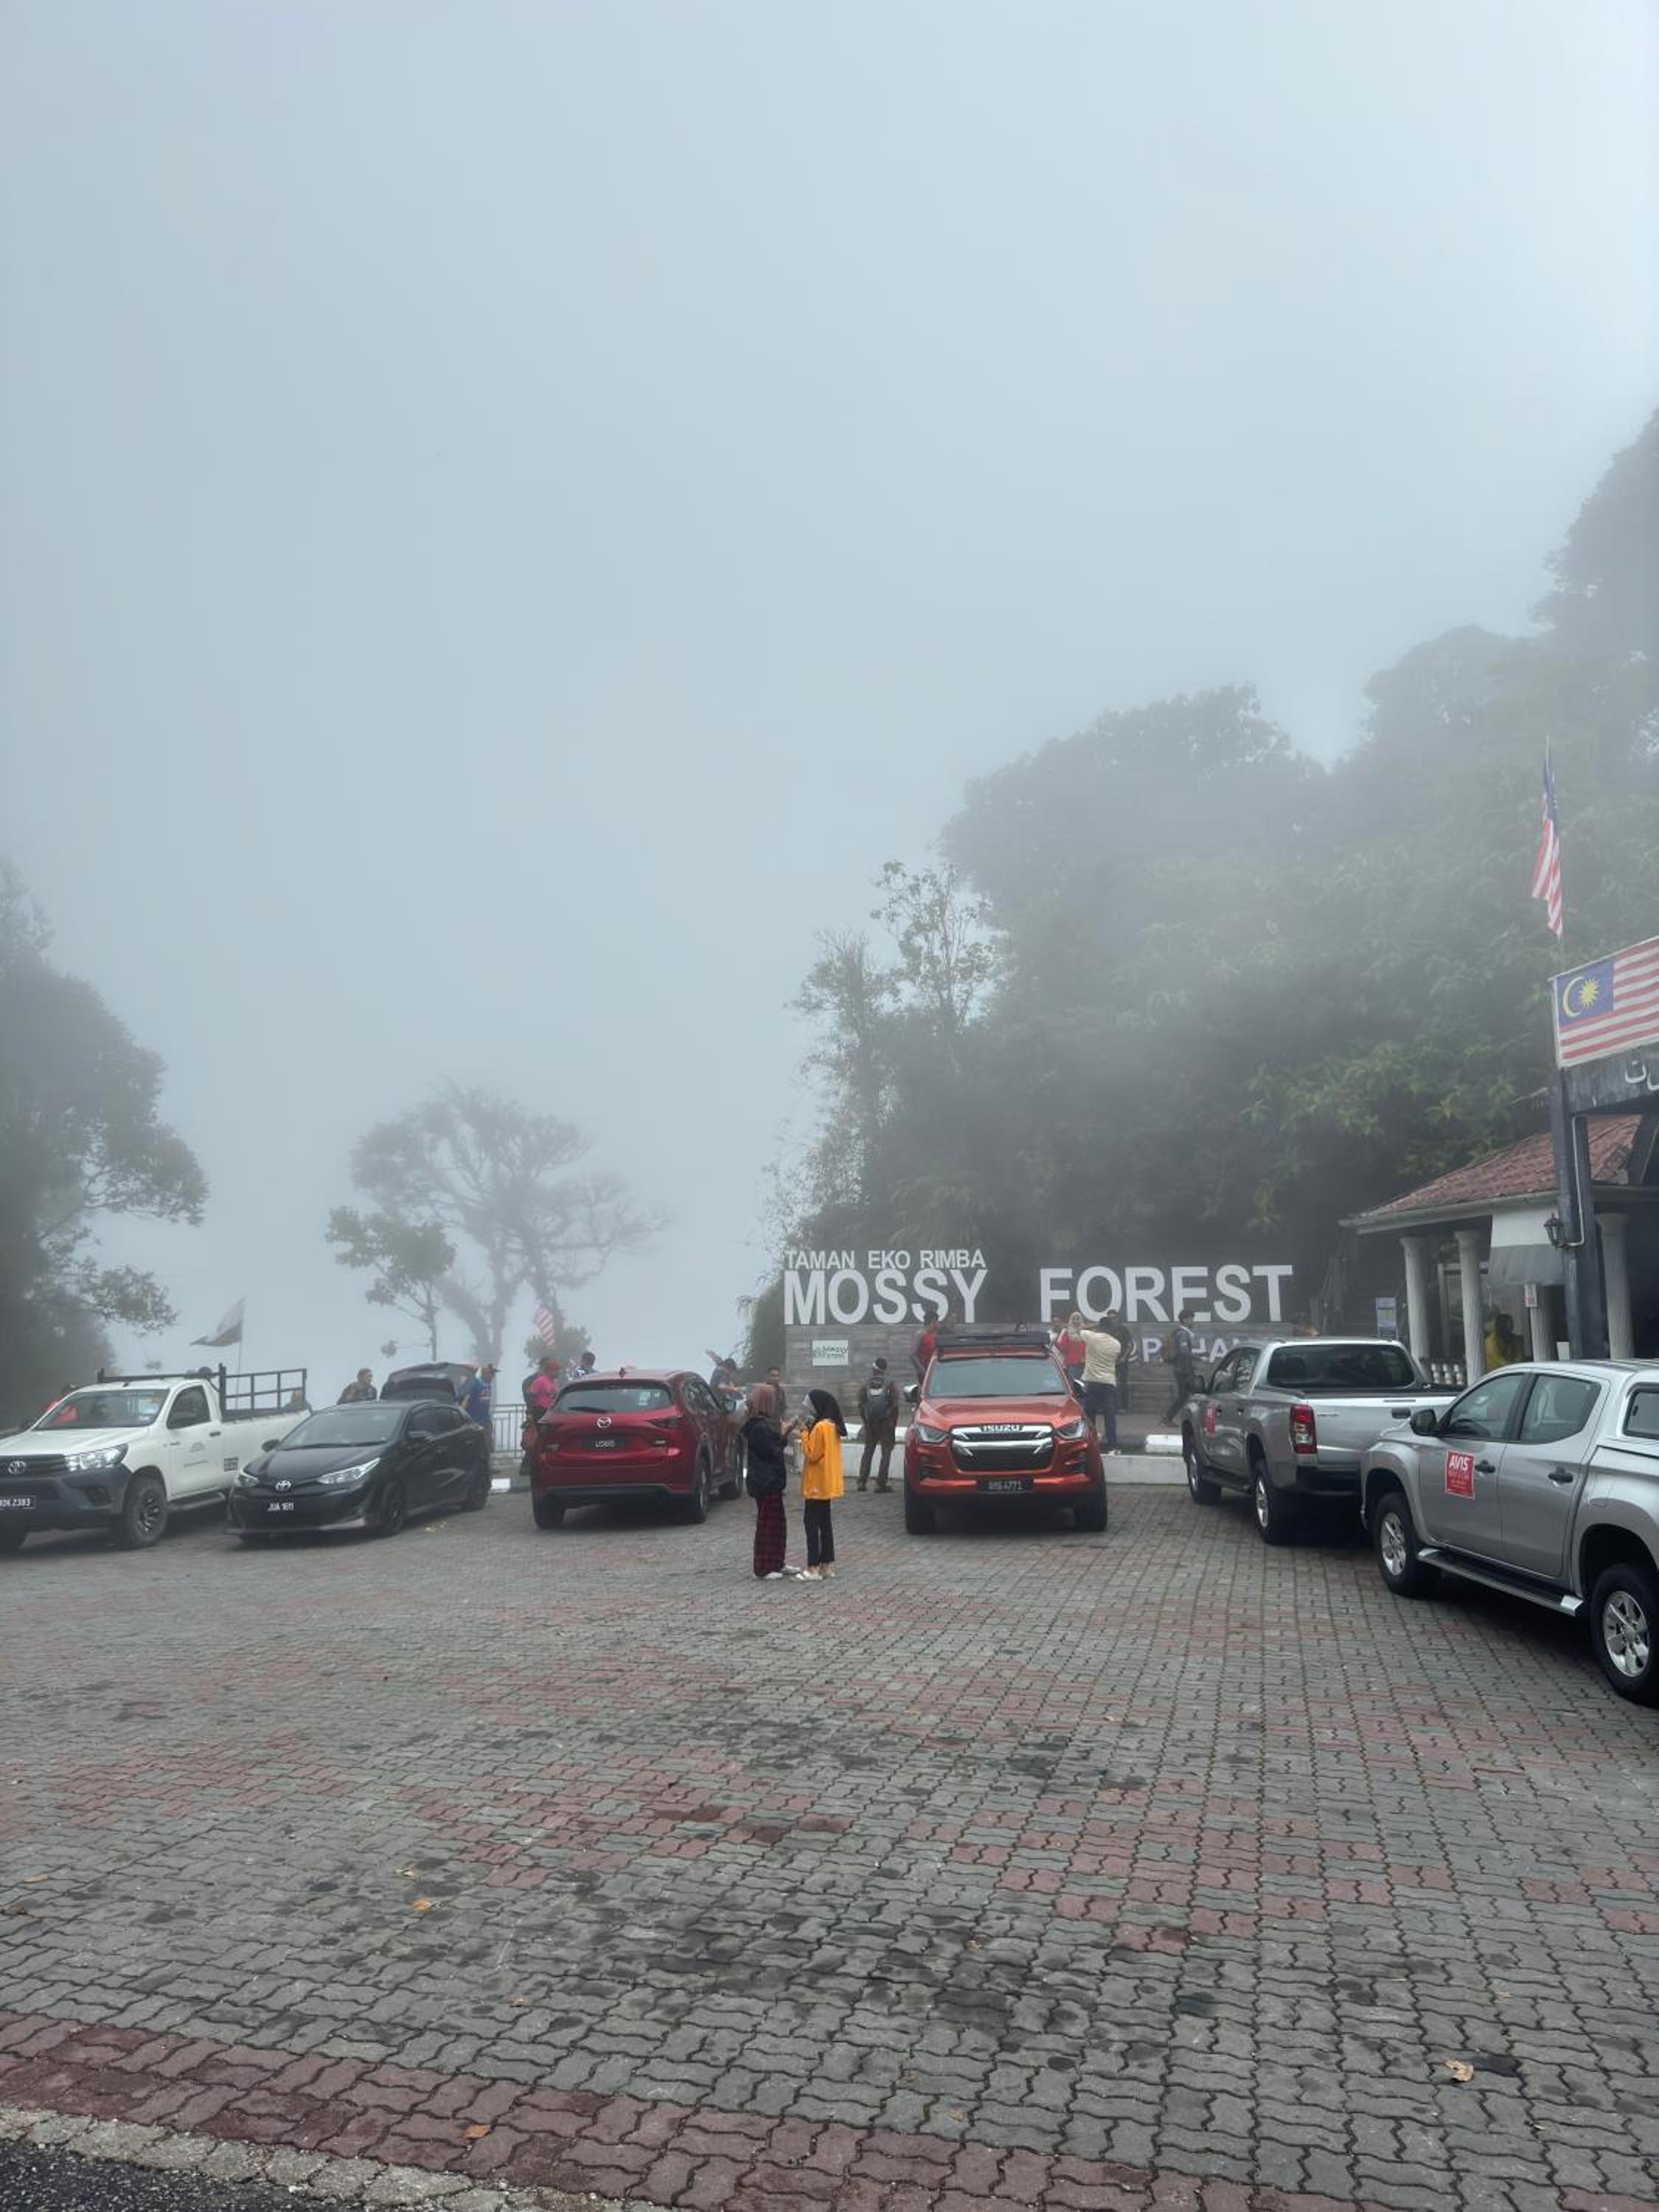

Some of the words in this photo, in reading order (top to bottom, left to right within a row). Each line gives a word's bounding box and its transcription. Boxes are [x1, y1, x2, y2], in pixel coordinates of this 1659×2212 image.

[785, 1250, 855, 1269] TAMAN
[868, 1250, 911, 1269] EKO
[919, 1249, 987, 1268] RIMBA
[784, 1268, 988, 1325] MOSSY
[1039, 1265, 1293, 1322] FOREST
[982, 1424, 1020, 1432] ISUZU
[1449, 1454, 1472, 1471] AVIS
